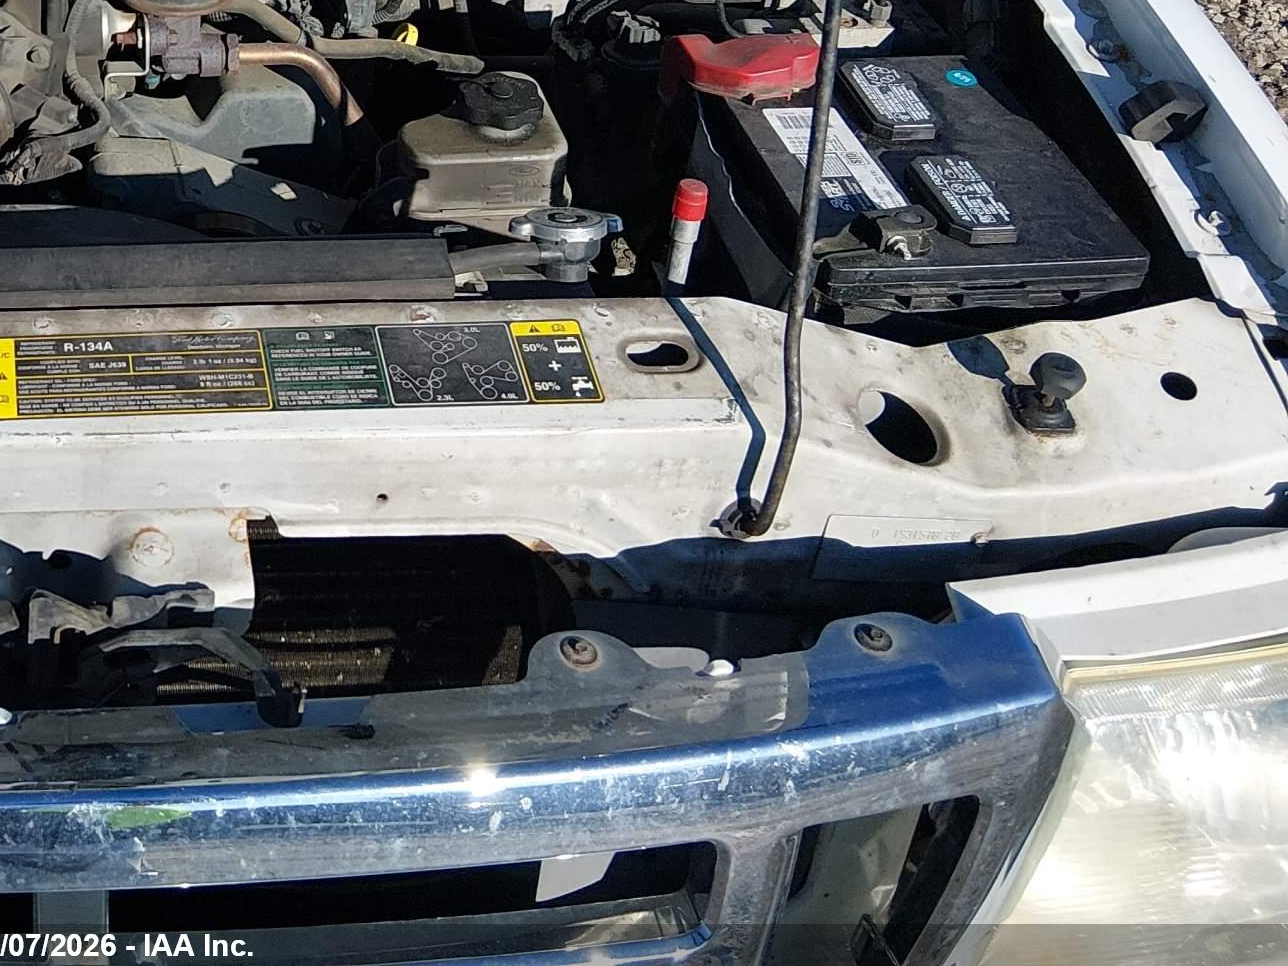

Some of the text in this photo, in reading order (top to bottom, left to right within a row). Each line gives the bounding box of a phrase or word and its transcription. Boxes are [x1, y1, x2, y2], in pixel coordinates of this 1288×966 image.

[64, 342, 113, 352] R-134A
[522, 343, 548, 352] 50%
[534, 382, 561, 391] 50%
